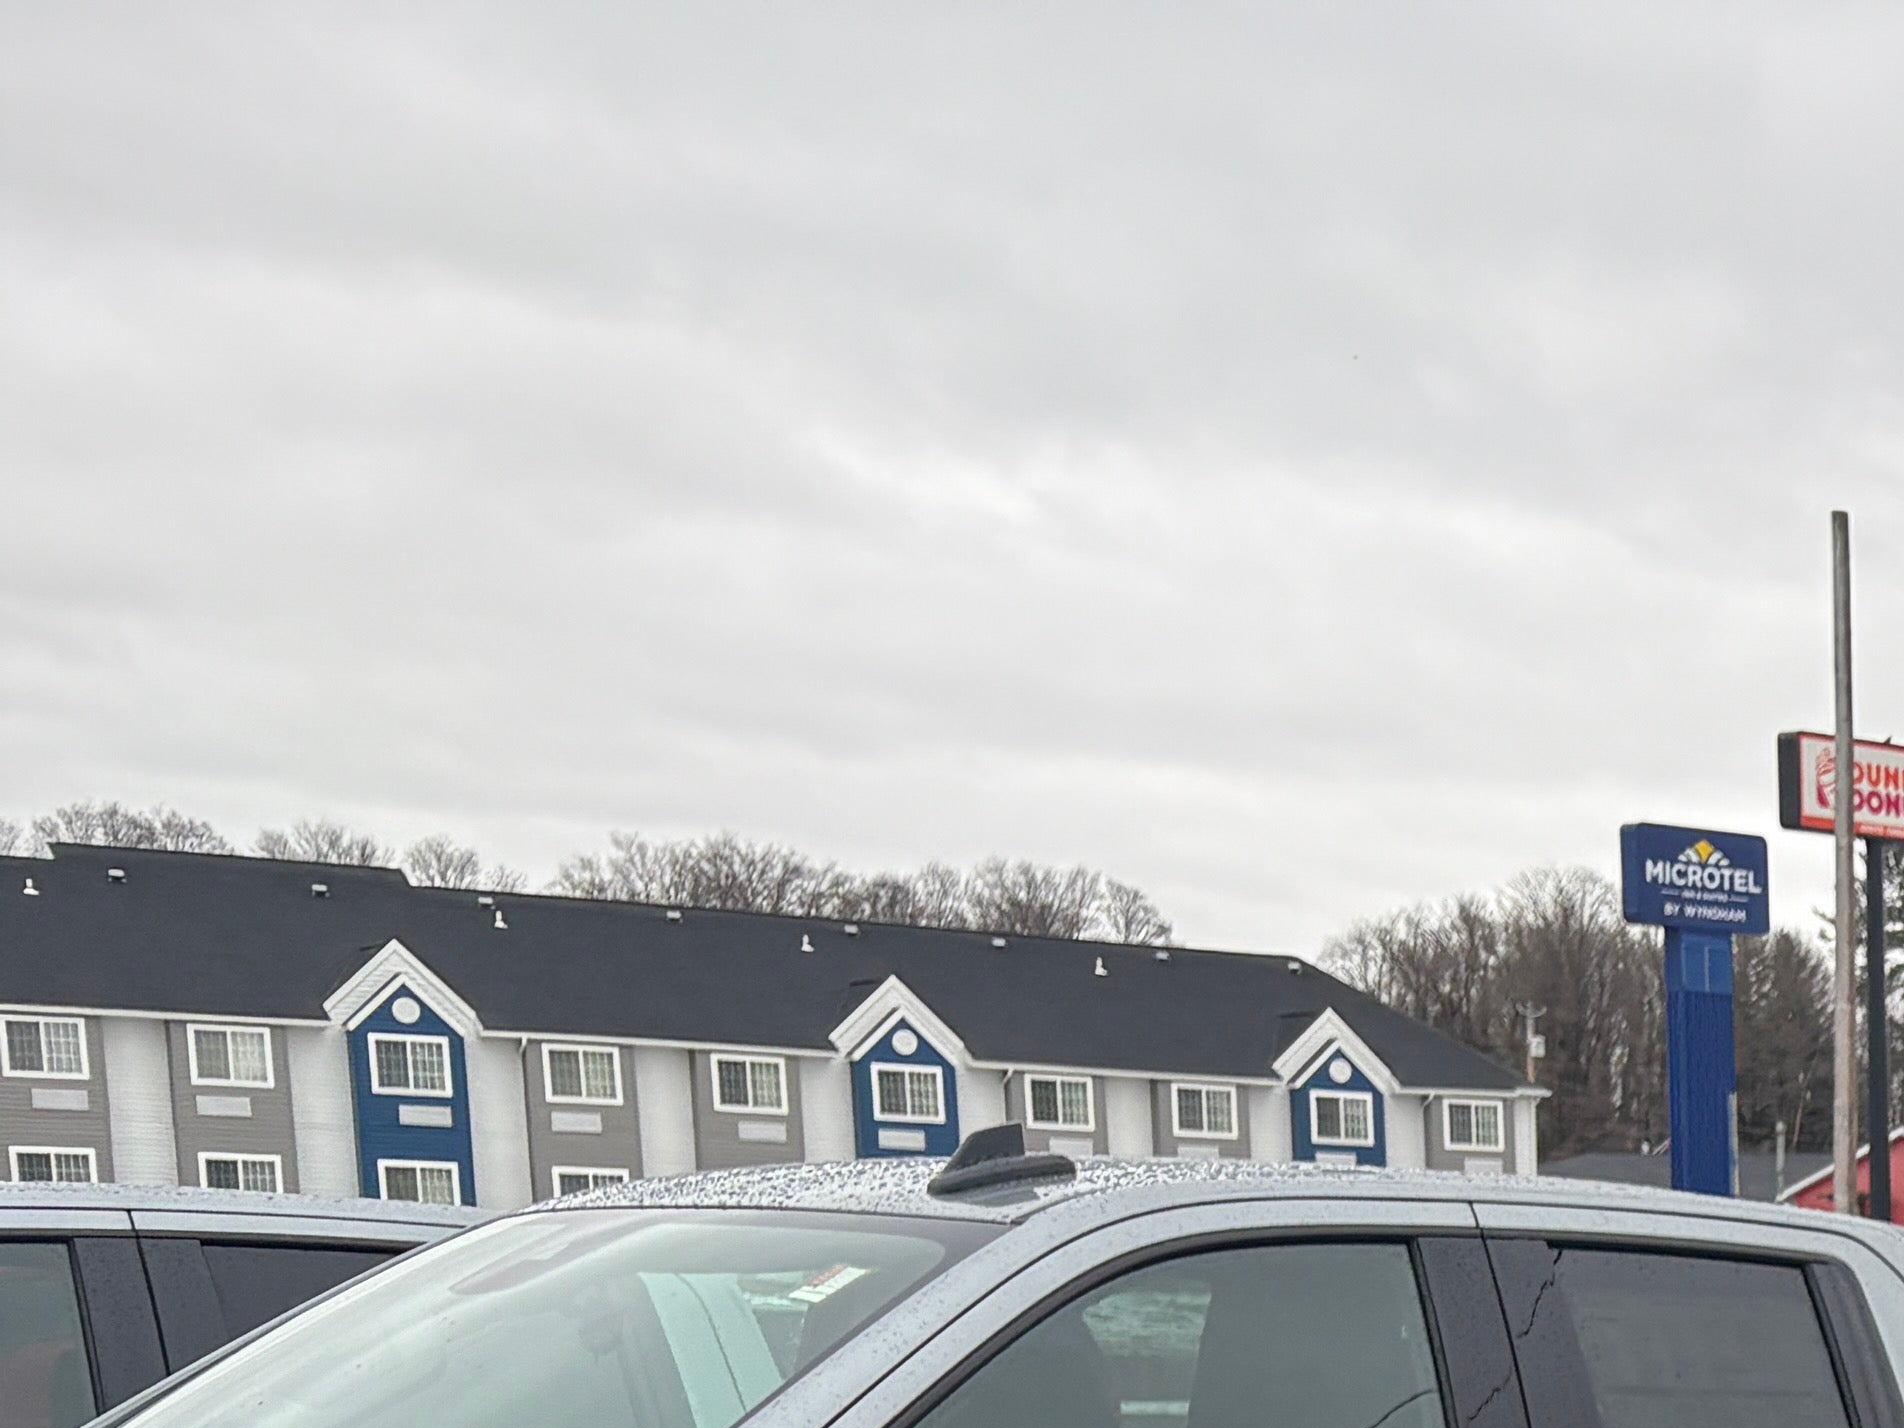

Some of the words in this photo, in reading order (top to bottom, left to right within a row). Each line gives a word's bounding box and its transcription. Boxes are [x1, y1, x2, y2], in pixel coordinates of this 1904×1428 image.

[1645, 858, 1762, 894] MICROTEL
[1663, 901, 1681, 917] BY
[1683, 903, 1747, 923] WYNDHAM
